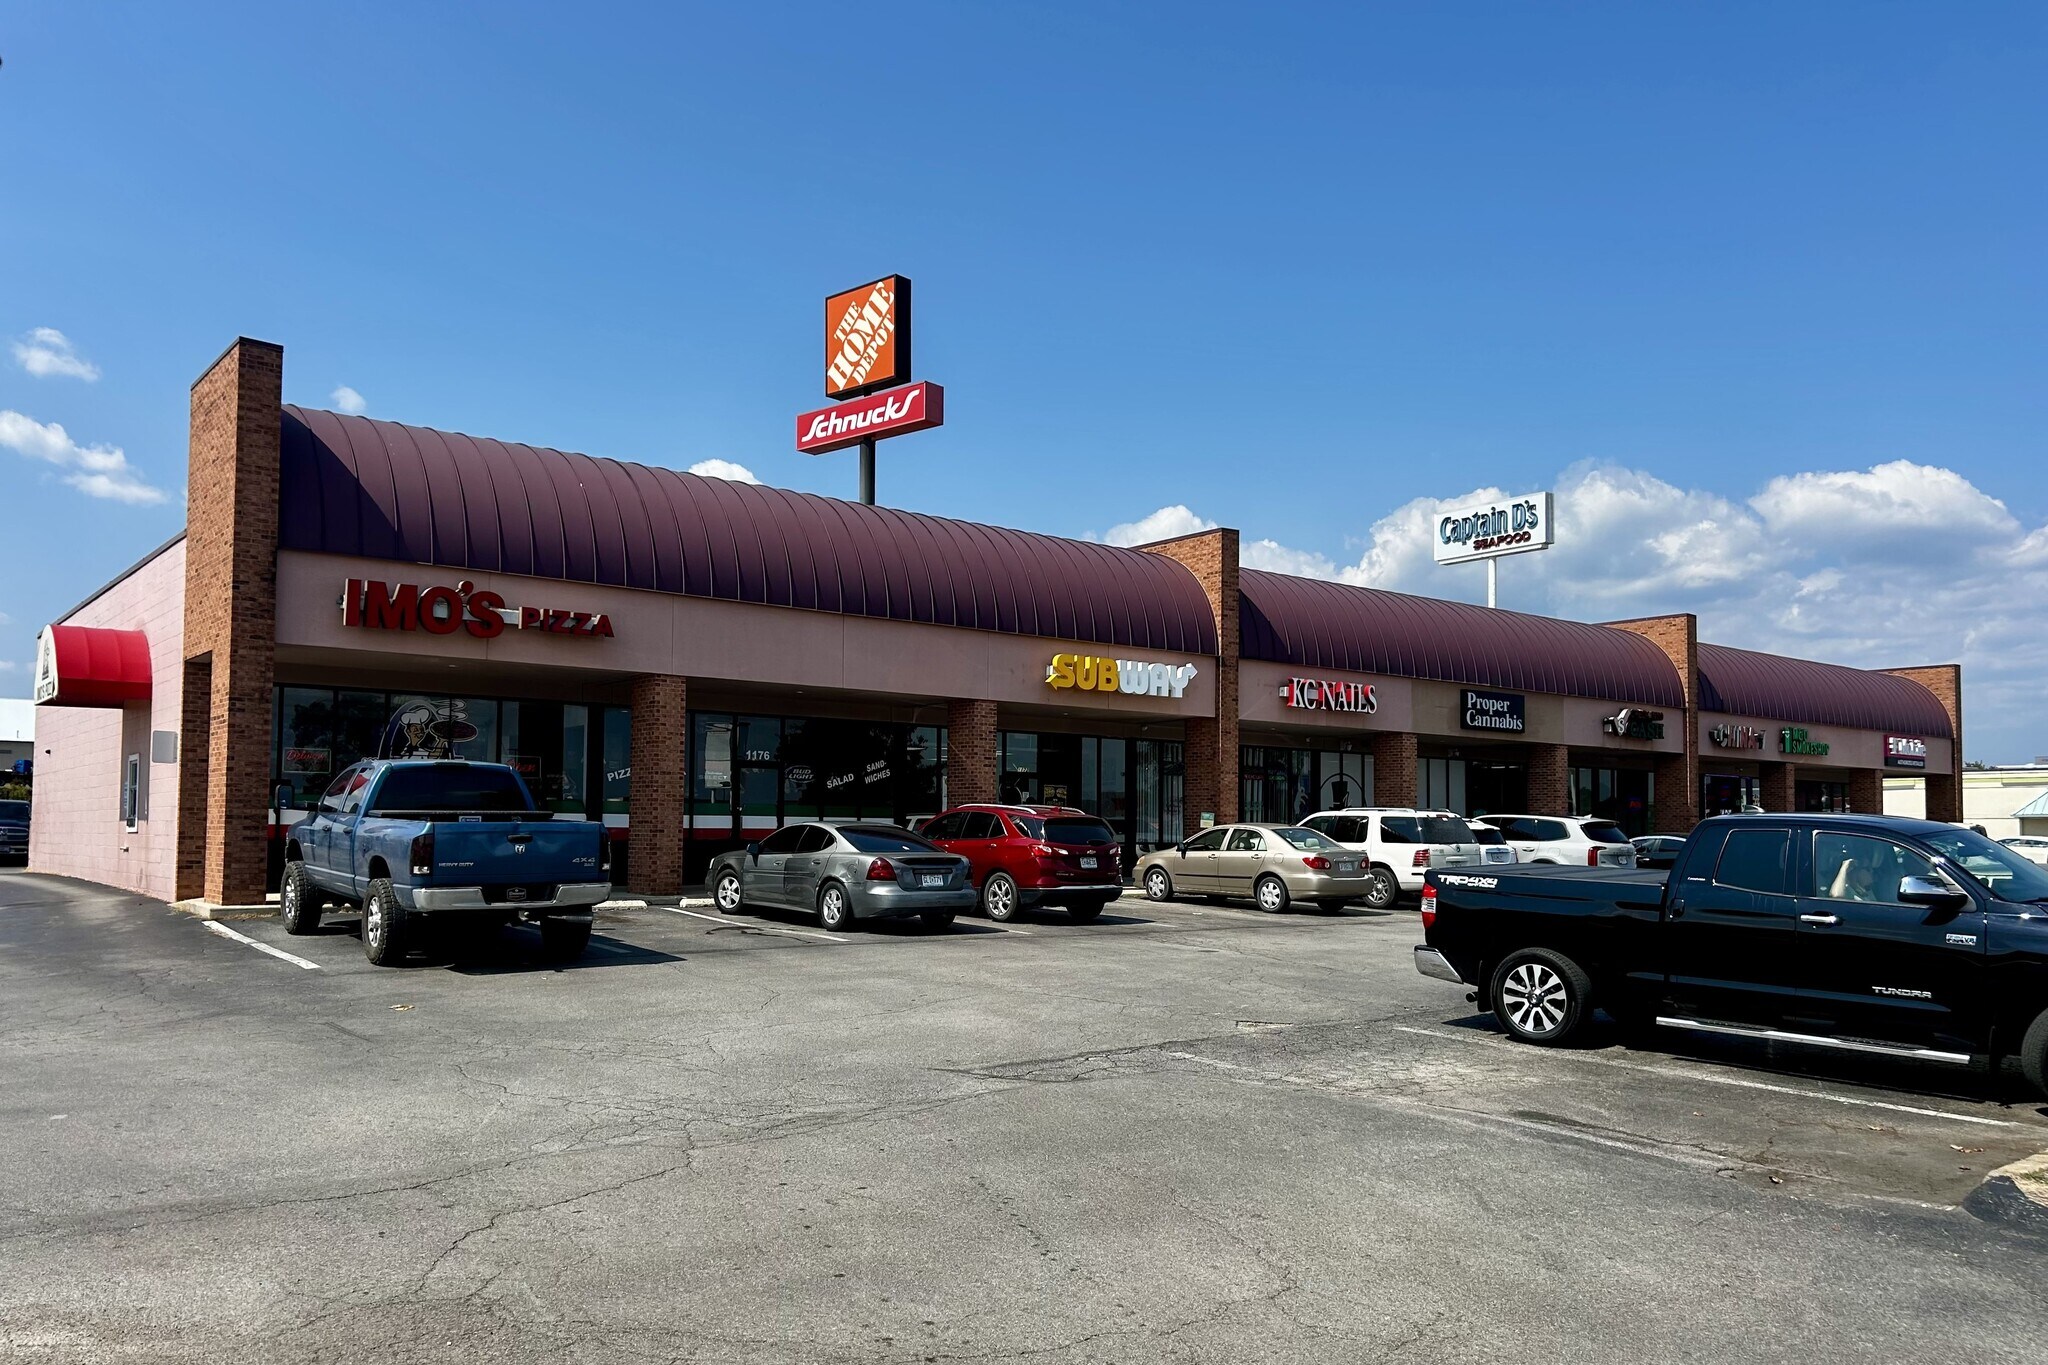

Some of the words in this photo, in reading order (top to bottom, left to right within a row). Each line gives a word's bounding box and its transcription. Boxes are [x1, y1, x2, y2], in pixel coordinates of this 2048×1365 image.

[834, 301, 862, 343] THE
[827, 281, 895, 390] HOME
[852, 313, 895, 385] DEPOT
[1440, 506, 1509, 546] Captain
[1511, 499, 1539, 531] D's
[1473, 530, 1532, 552] SEAFOOD
[344, 578, 506, 639] IMO'S
[518, 606, 615, 638] PIZZA
[1045, 653, 1198, 699] SUBWAY
[1288, 677, 1317, 710] KC
[1319, 680, 1378, 714] NAILS
[1467, 691, 1511, 716] Proper
[1466, 709, 1523, 731] Cannabis
[1718, 723, 1757, 749] CHINA
[746, 750, 770, 760] 1176
[866, 759, 887, 773] SAND-
[826, 773, 855, 789] SALAD
[864, 768, 891, 785] WICHES
[1871, 986, 1932, 999] TUNDRA
